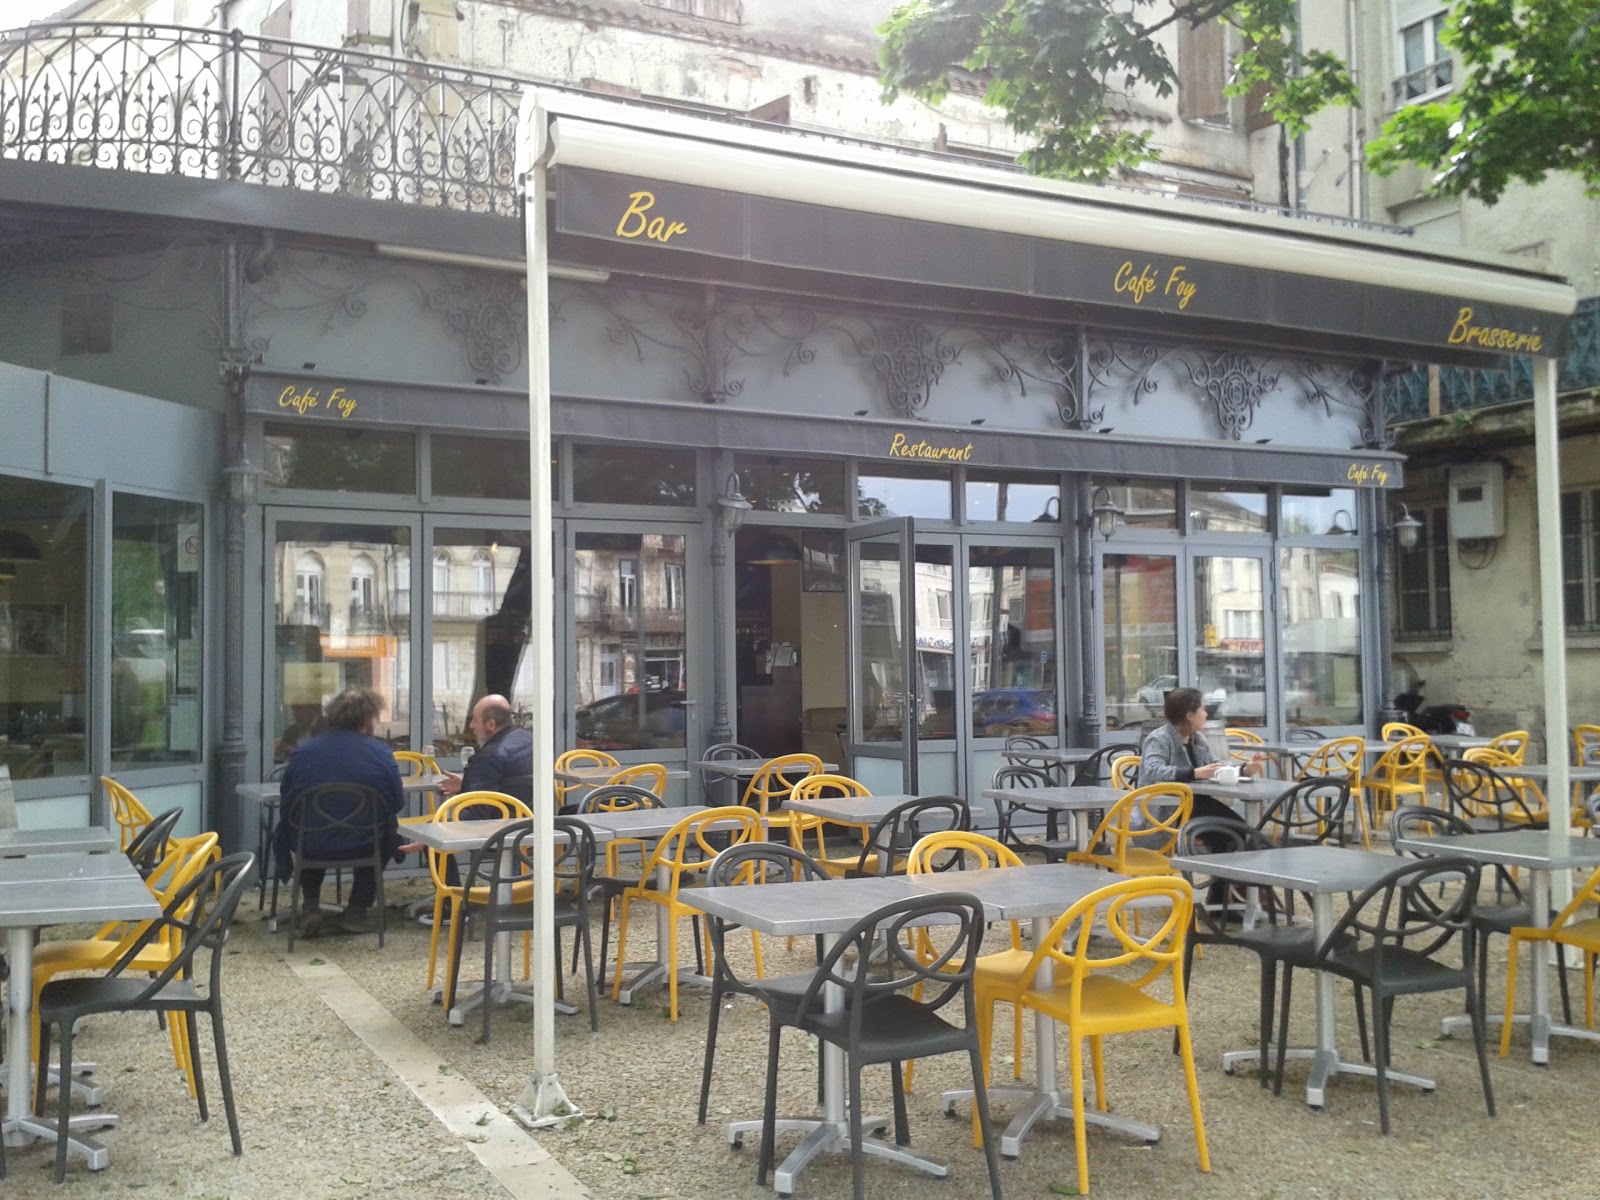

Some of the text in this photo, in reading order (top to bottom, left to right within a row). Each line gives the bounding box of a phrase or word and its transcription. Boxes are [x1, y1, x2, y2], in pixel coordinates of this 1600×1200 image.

[615, 191, 688, 243] Bar
[1114, 261, 1196, 310] Café Foy
[1447, 306, 1542, 353] Brasserie
[278, 385, 357, 418] Café Foy
[889, 432, 973, 463] Restaurant
[1347, 463, 1388, 487] Café Foy
